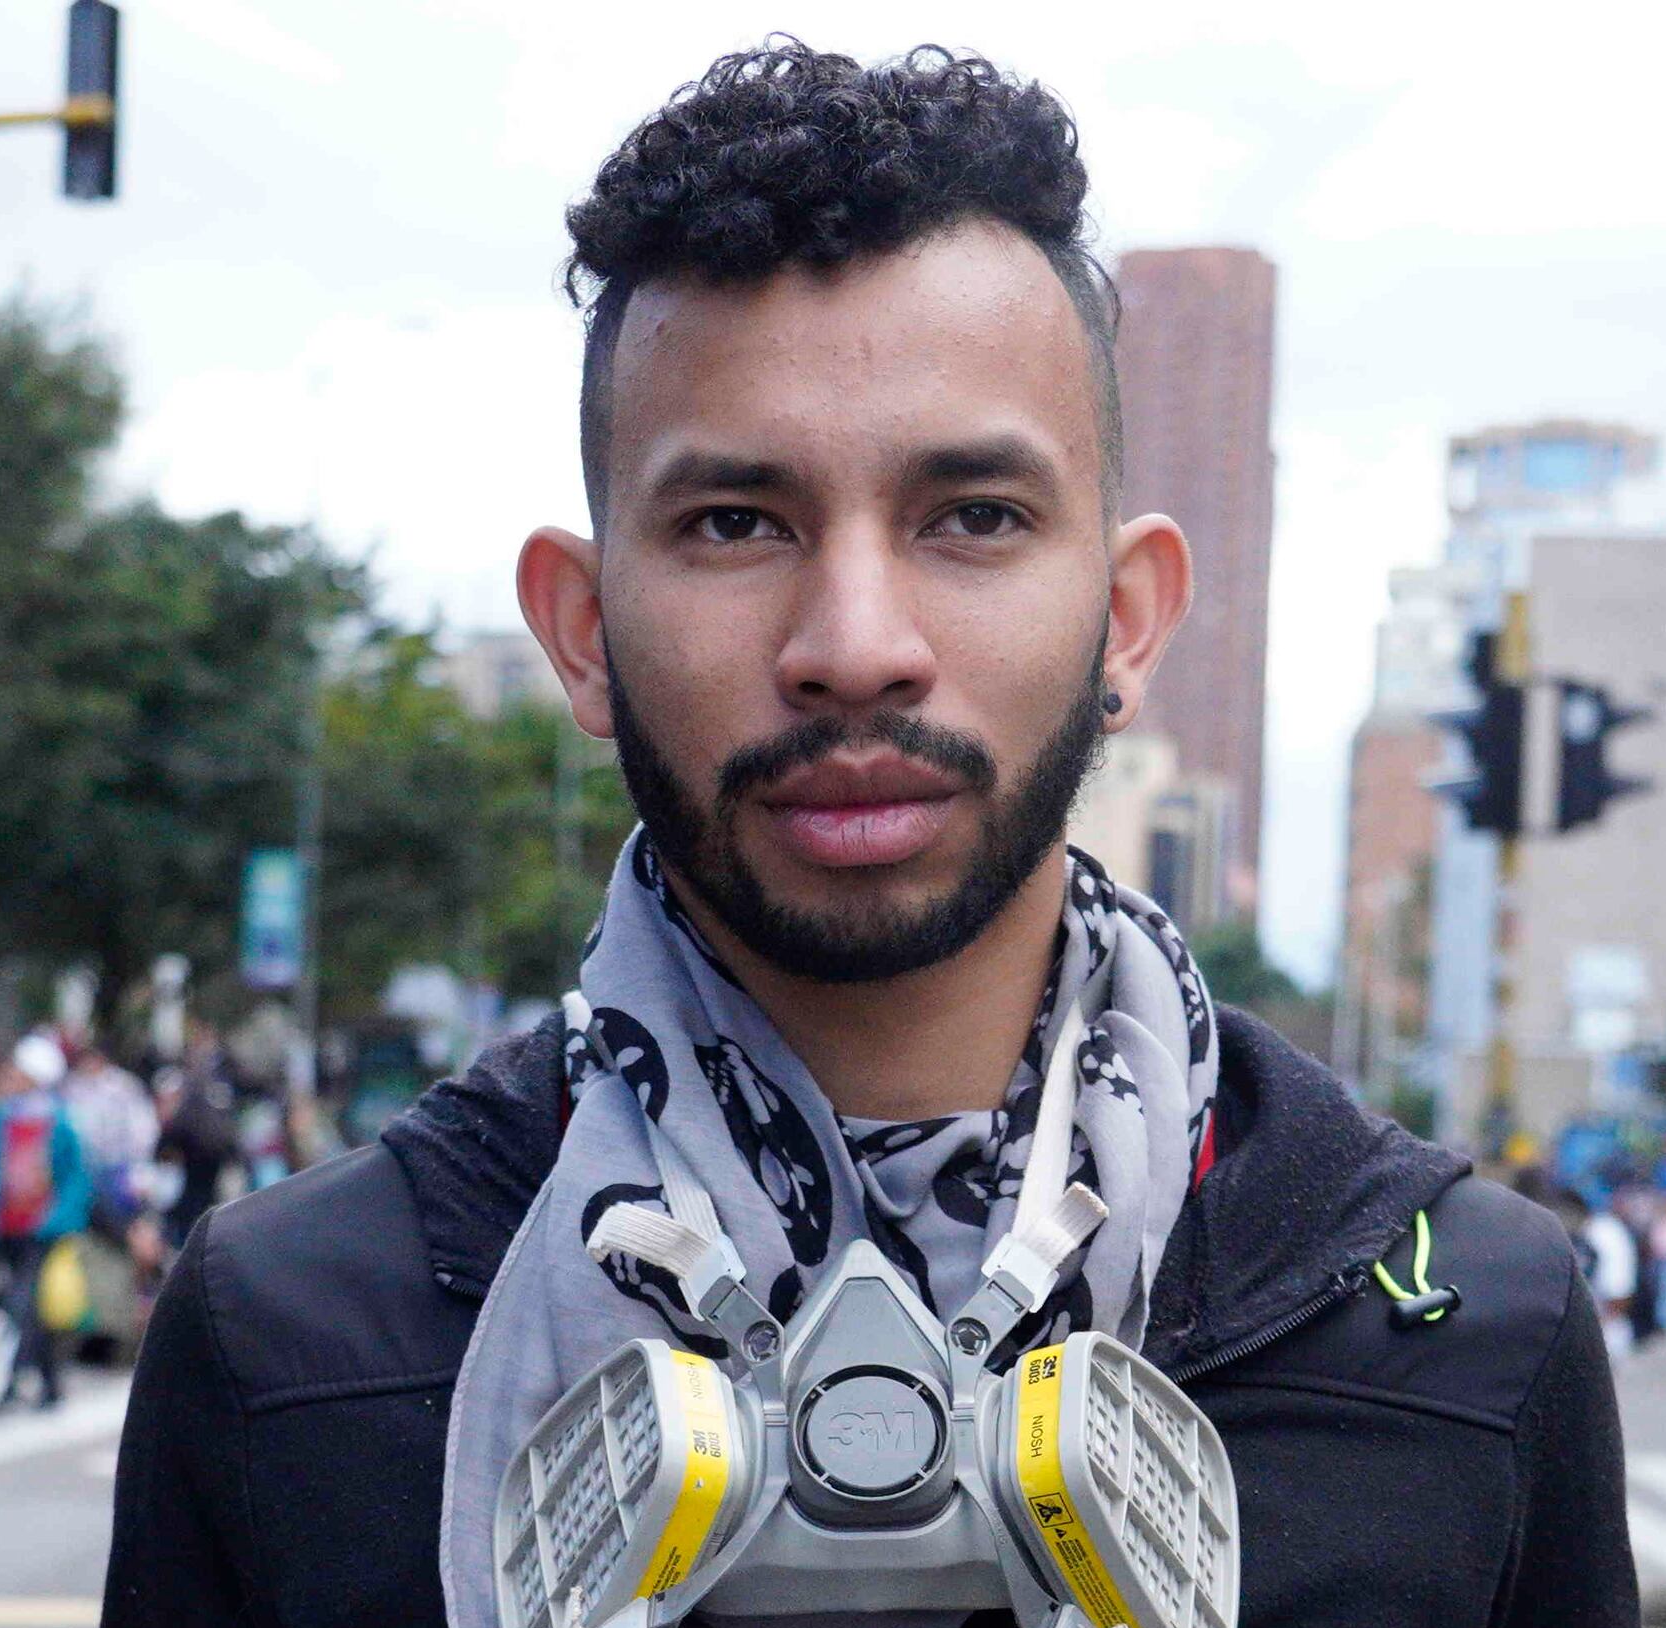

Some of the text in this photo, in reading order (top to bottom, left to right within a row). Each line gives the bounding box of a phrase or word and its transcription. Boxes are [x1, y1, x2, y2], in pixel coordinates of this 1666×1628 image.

[1028, 1359, 1041, 1385] 6003
[1043, 1355, 1057, 1379] 3M
[693, 1429, 707, 1455] 3M
[828, 1411, 916, 1451] 3M
[1030, 1415, 1043, 1458] NIOSH
[708, 1431, 721, 1458] 6003
